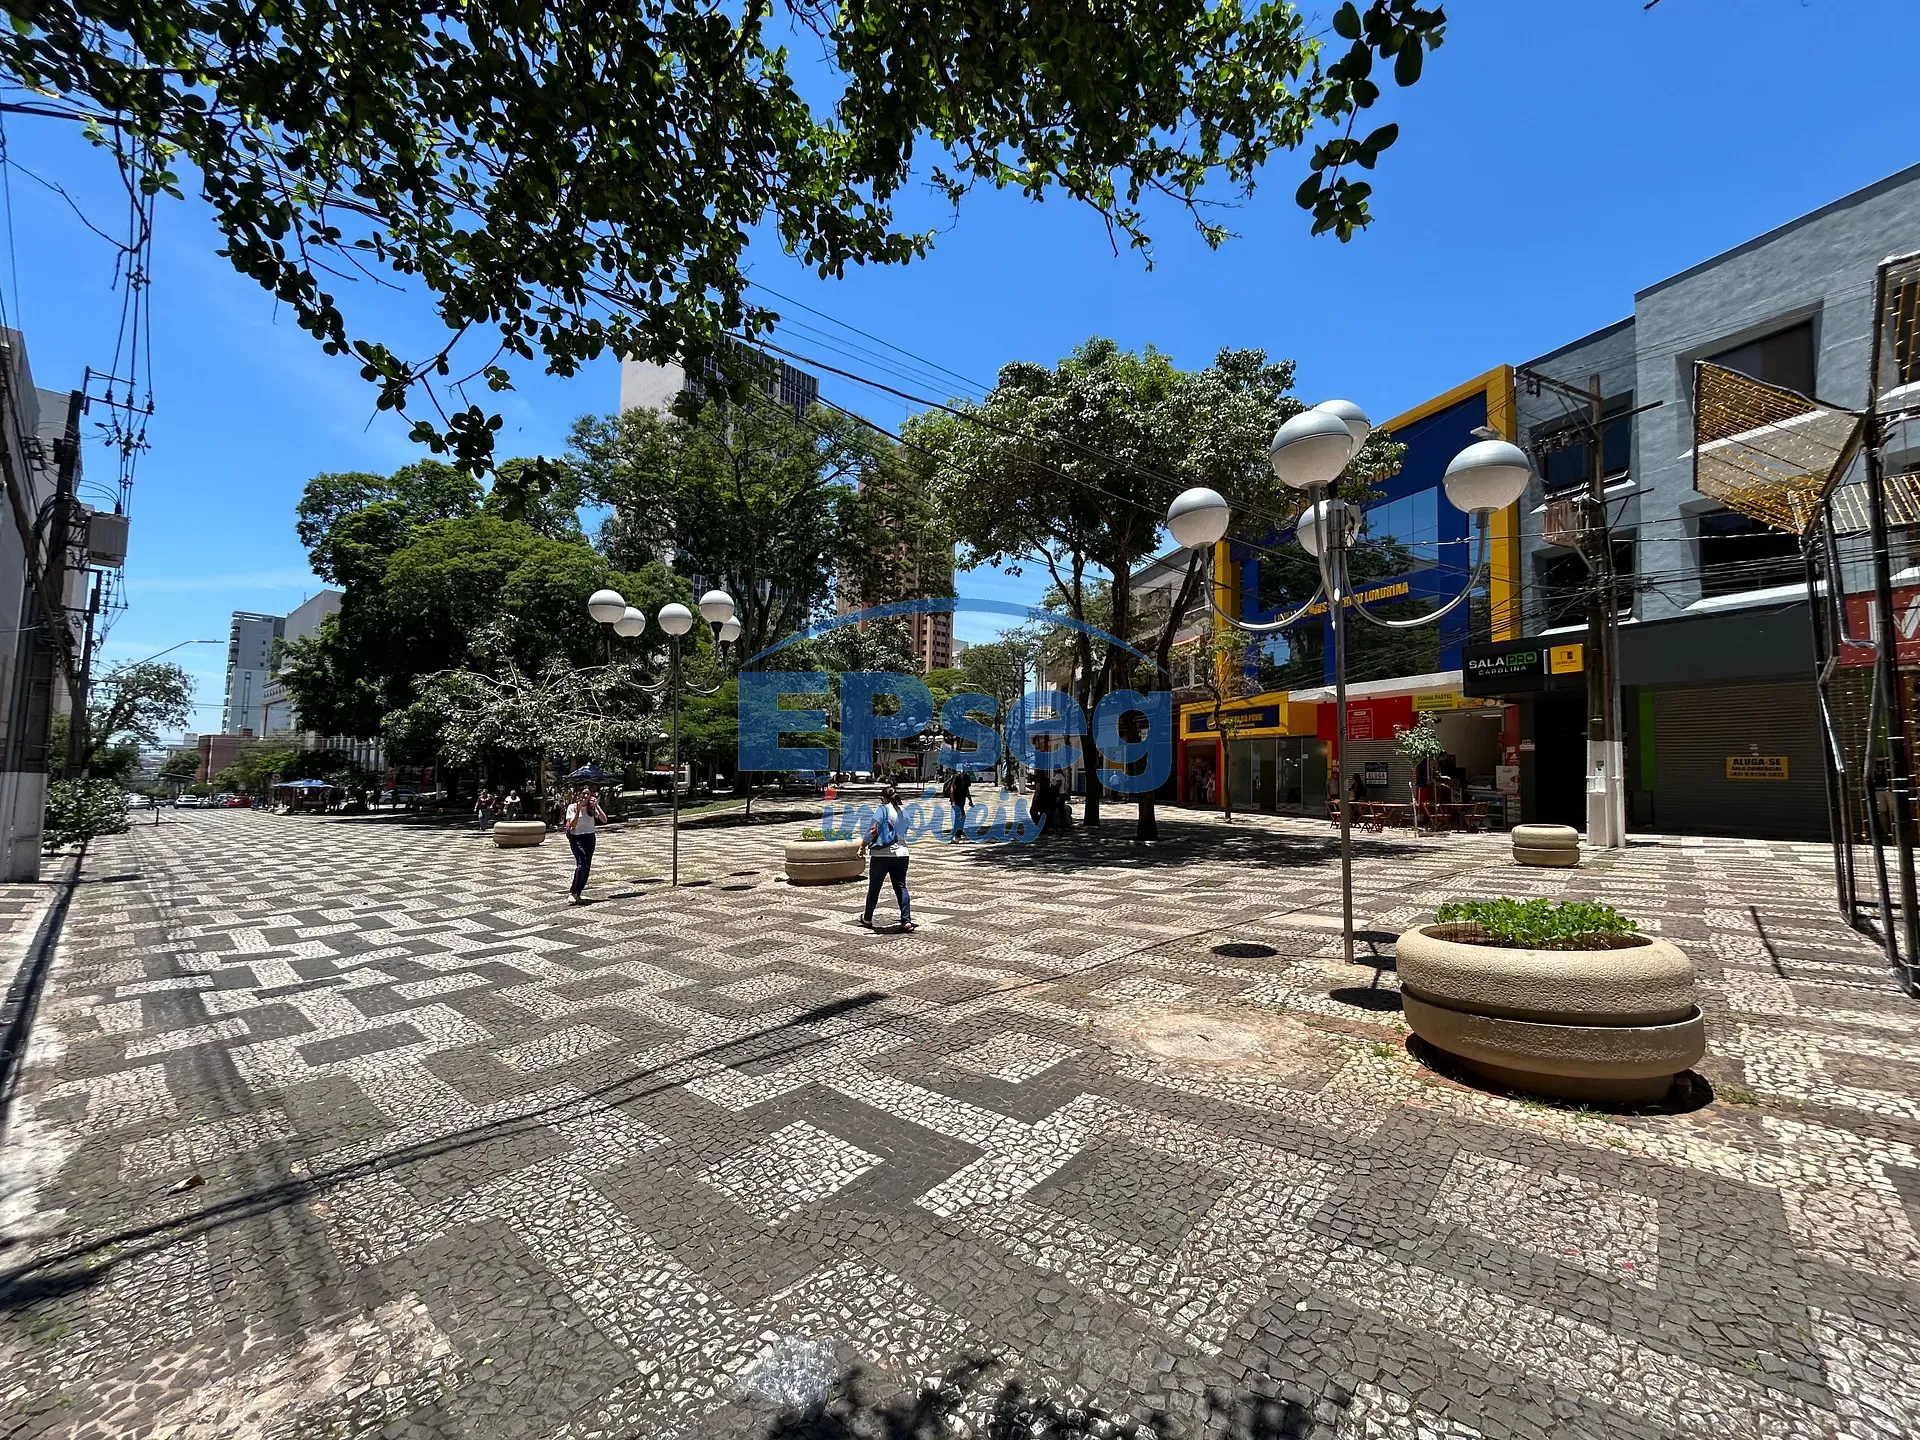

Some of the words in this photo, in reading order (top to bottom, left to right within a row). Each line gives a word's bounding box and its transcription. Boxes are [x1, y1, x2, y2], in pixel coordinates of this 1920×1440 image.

[1365, 581, 1409, 603] LONDRINA
[1469, 656, 1505, 669] SALA
[1506, 651, 1537, 666] PRO
[1478, 665, 1527, 676] CAROLINA
